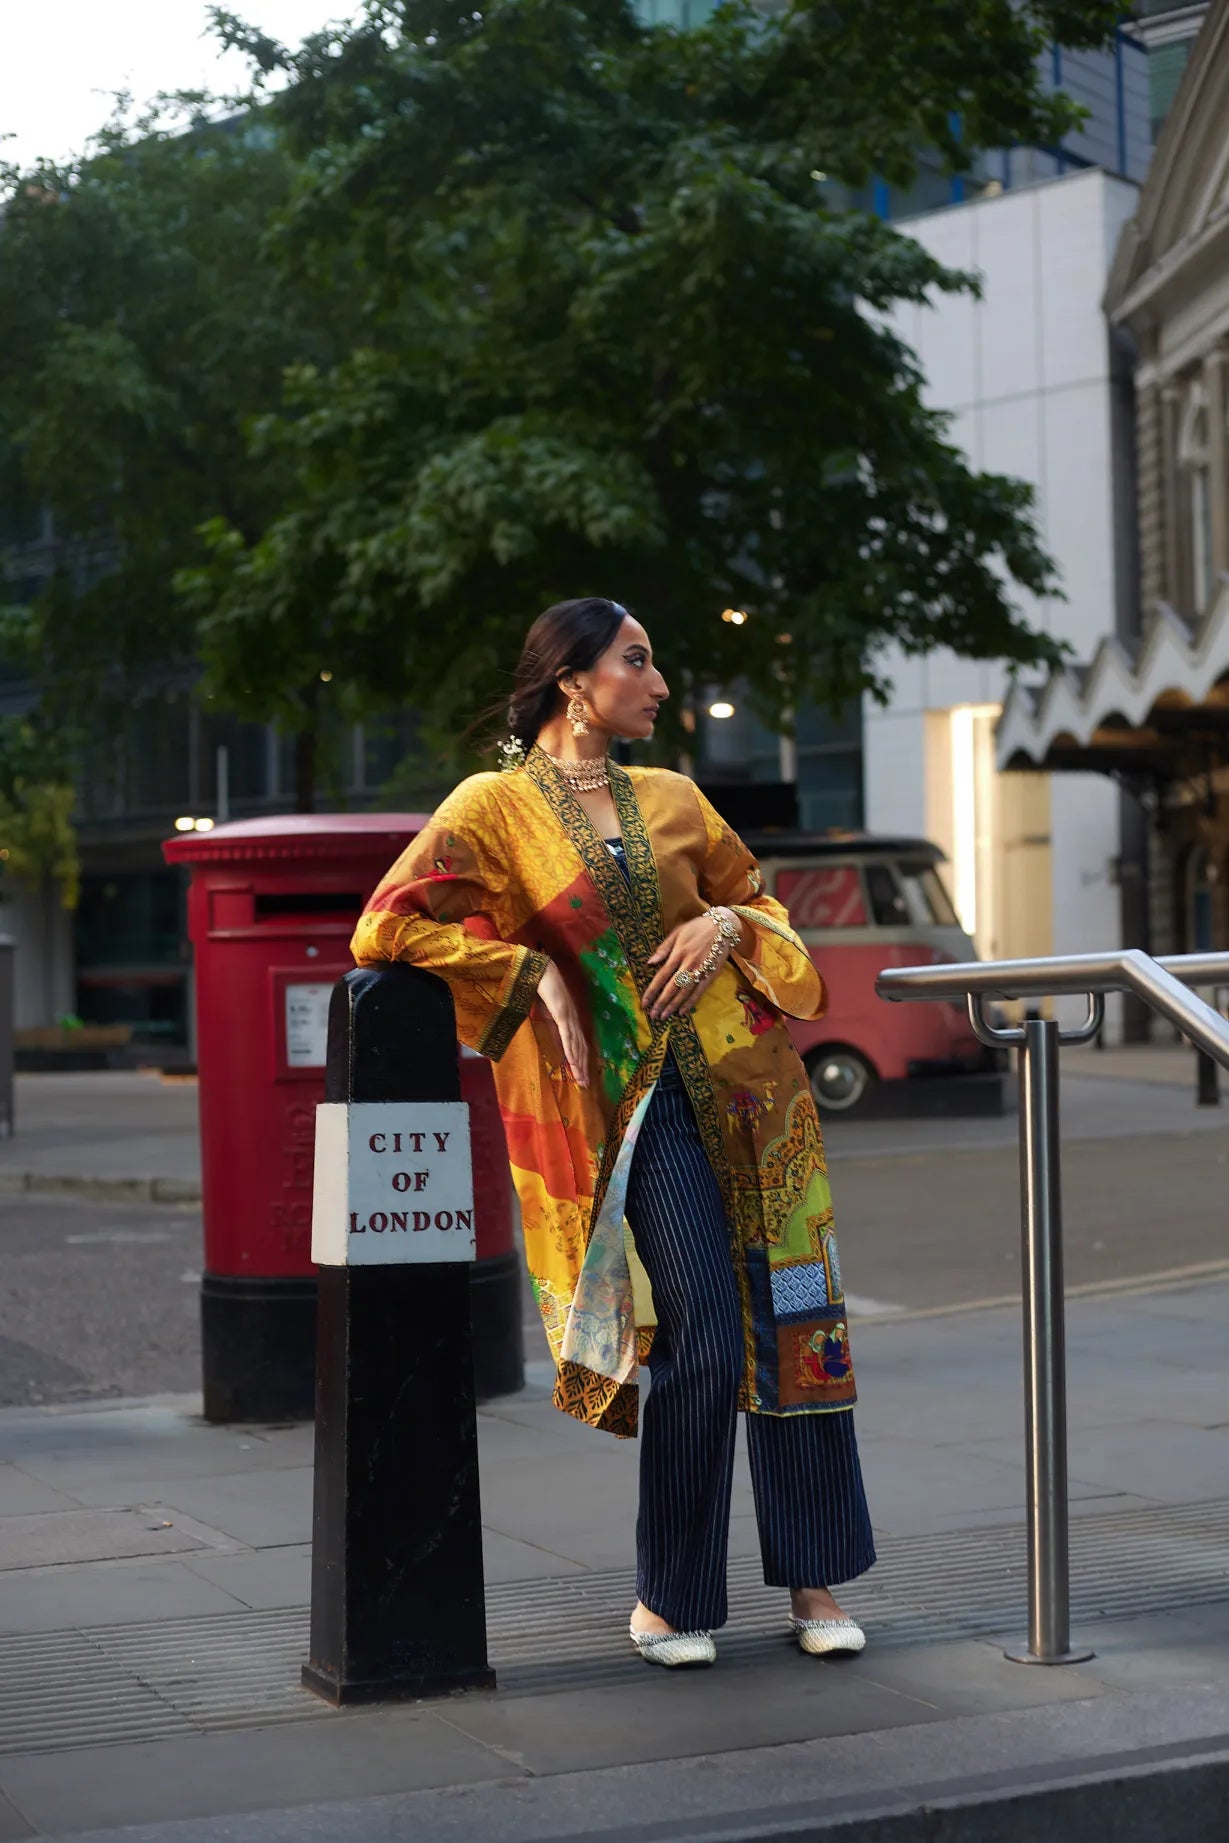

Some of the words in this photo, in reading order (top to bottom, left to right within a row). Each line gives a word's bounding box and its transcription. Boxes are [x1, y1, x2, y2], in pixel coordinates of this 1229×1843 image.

[368, 1132, 451, 1153] CITY
[391, 1171, 430, 1192] OF
[349, 1209, 474, 1234] LONDON
